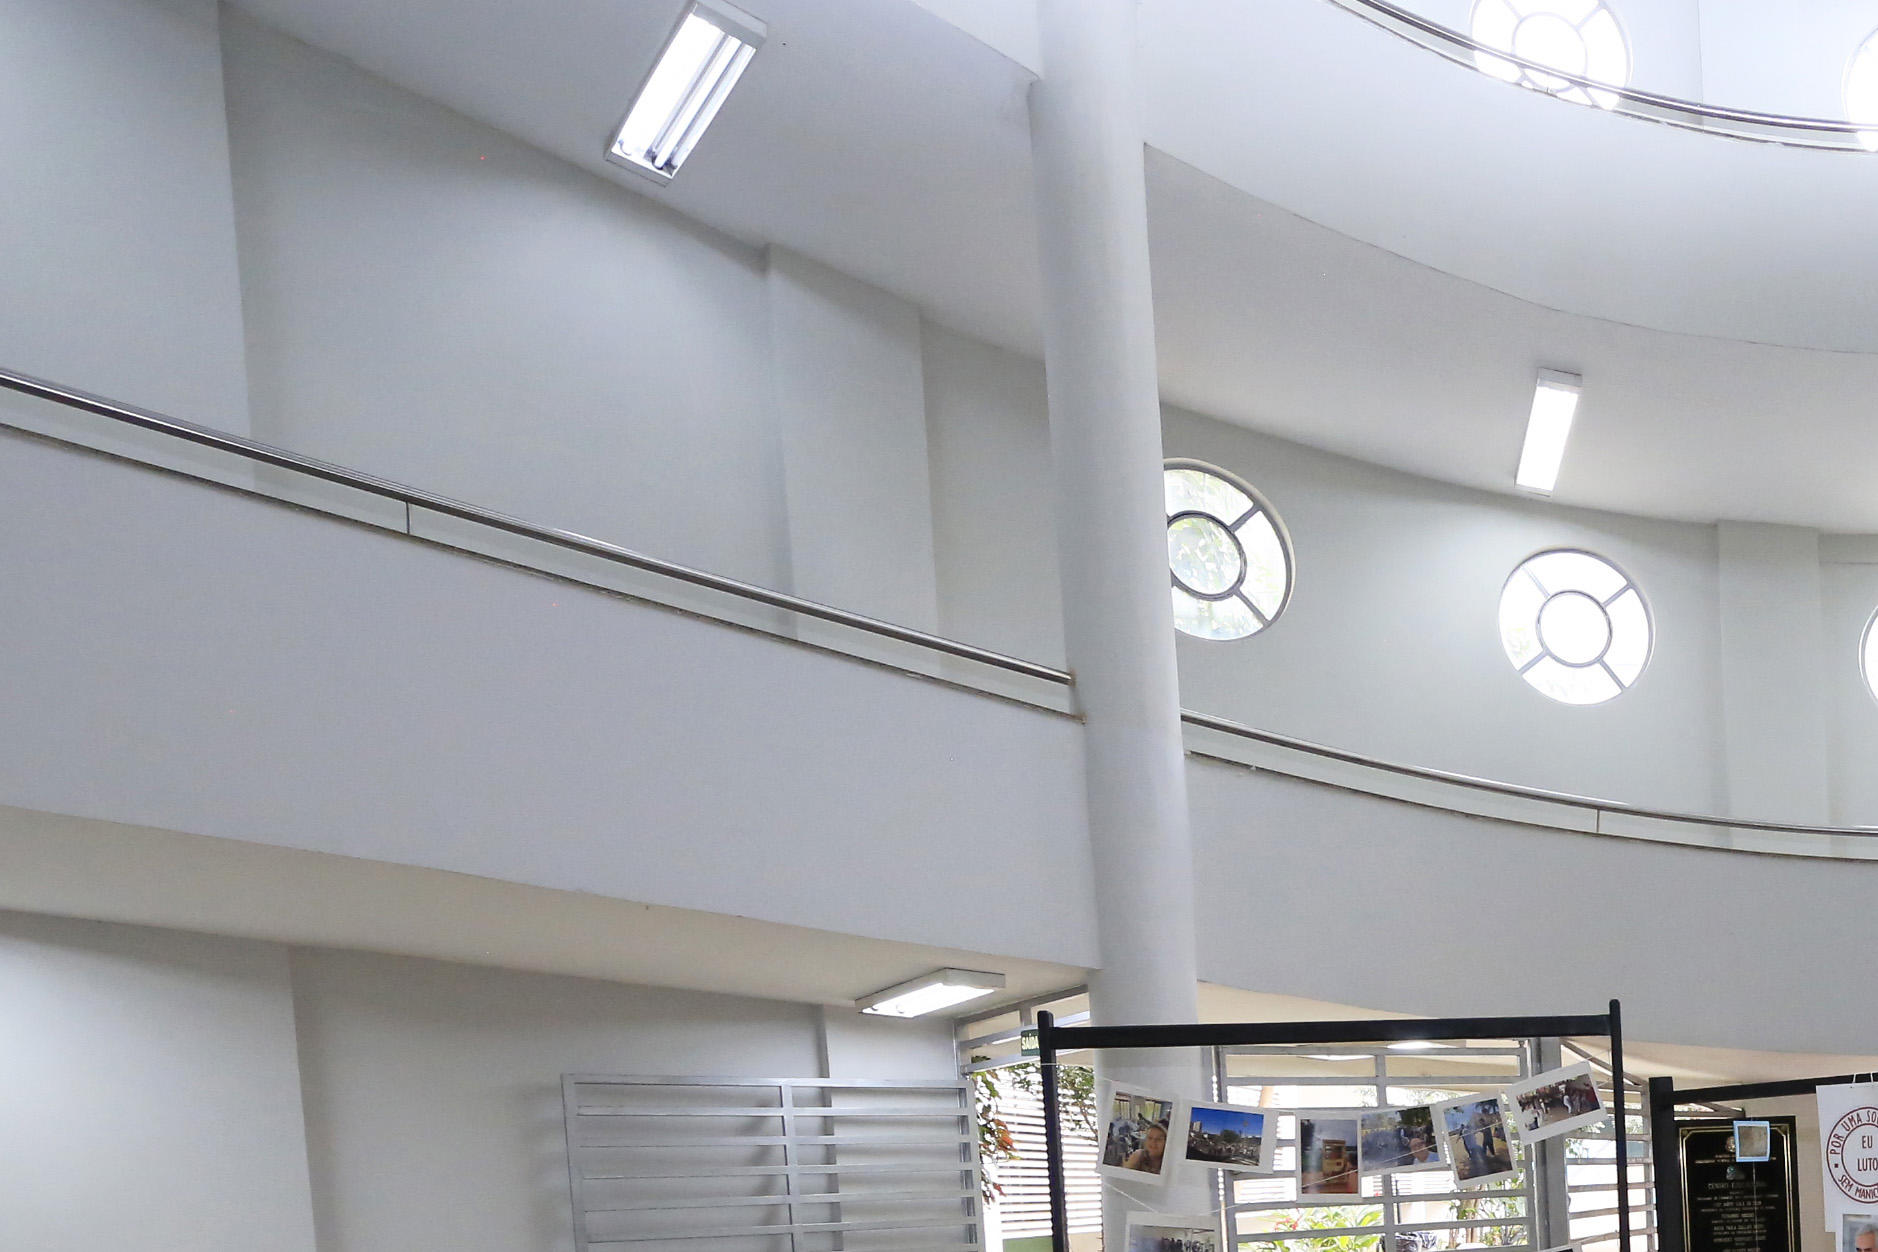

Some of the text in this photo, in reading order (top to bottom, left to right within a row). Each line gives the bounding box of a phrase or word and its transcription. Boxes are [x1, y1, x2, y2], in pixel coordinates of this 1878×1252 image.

[1830, 1133, 1845, 1155] POR
[1841, 1112, 1863, 1131] UMA
[1861, 1135, 1873, 1149] EU
[1857, 1158, 1878, 1171] LUTO
[1838, 1174, 1854, 1192] SEM
